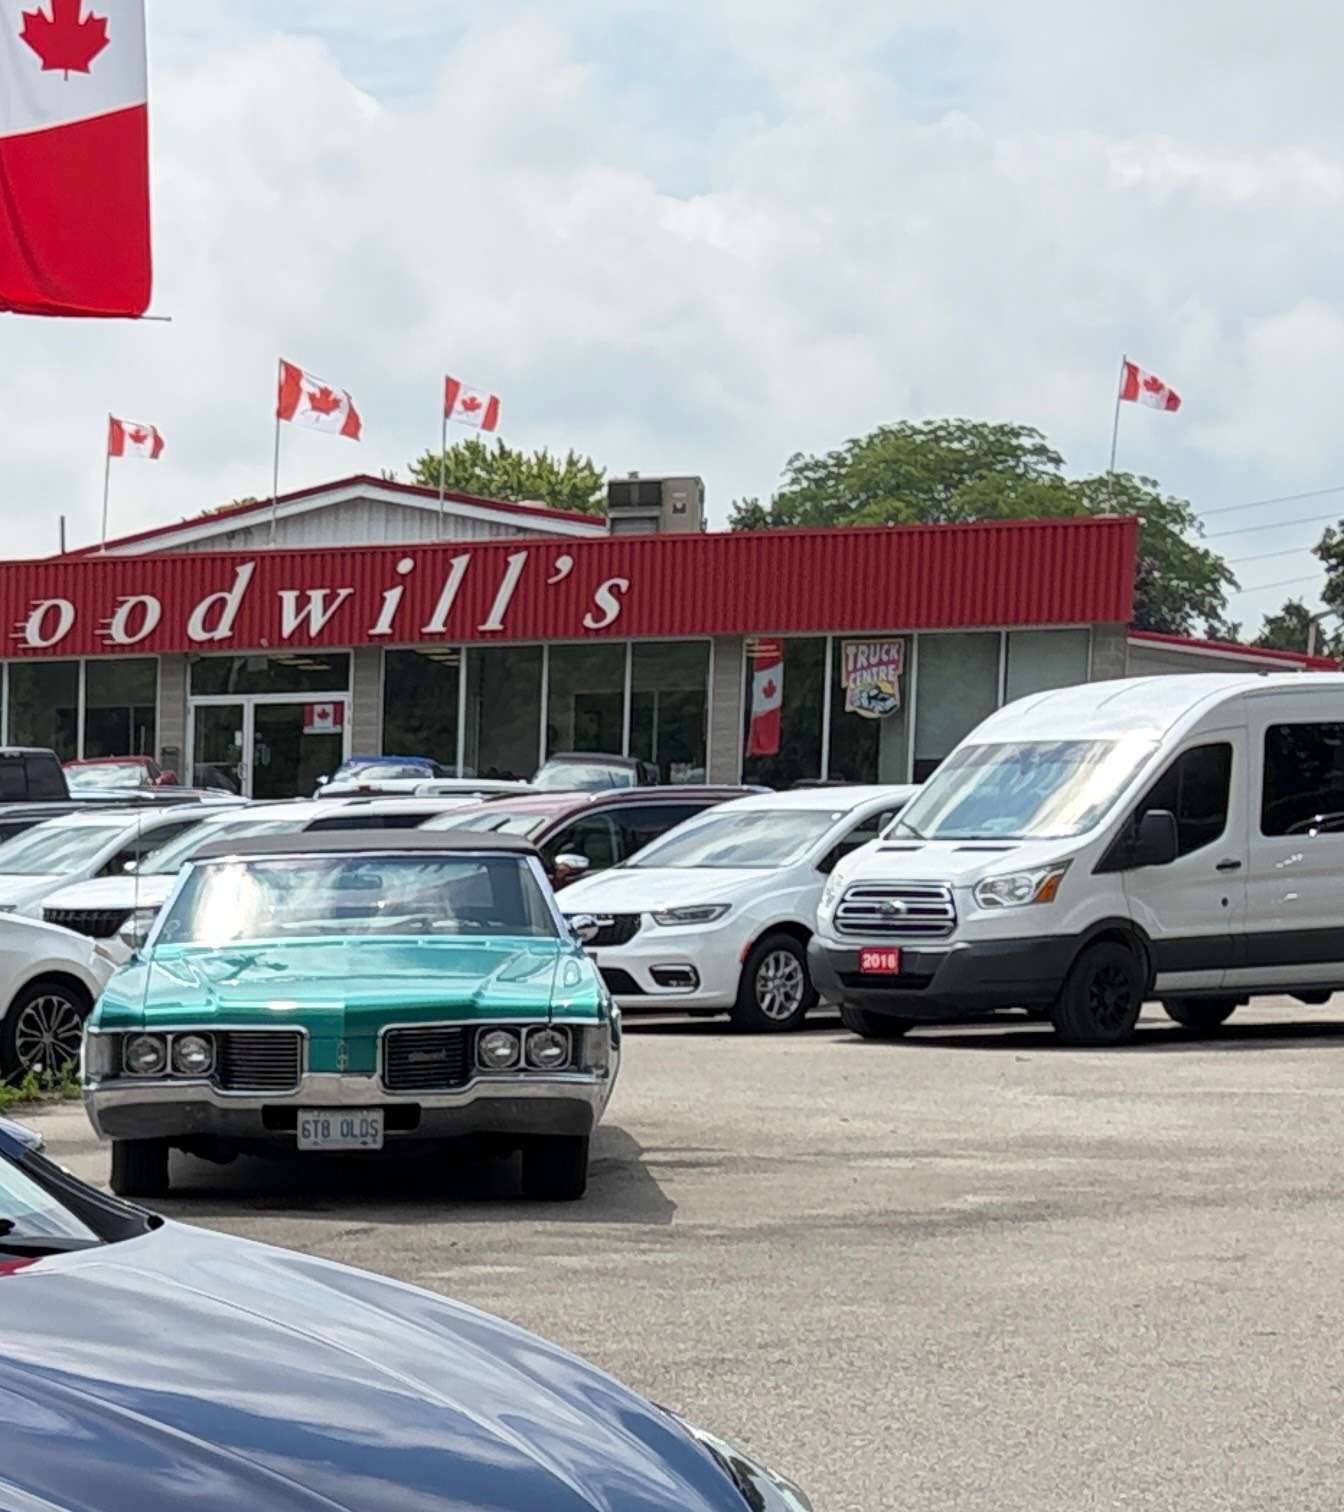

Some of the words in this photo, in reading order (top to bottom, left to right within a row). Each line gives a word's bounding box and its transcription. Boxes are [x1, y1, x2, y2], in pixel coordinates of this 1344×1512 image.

[846, 643, 900, 672] TRUCK
[849, 664, 897, 689] CENTRE
[302, 1119, 330, 1139] 6T8
[340, 1118, 378, 1139] OLDS
